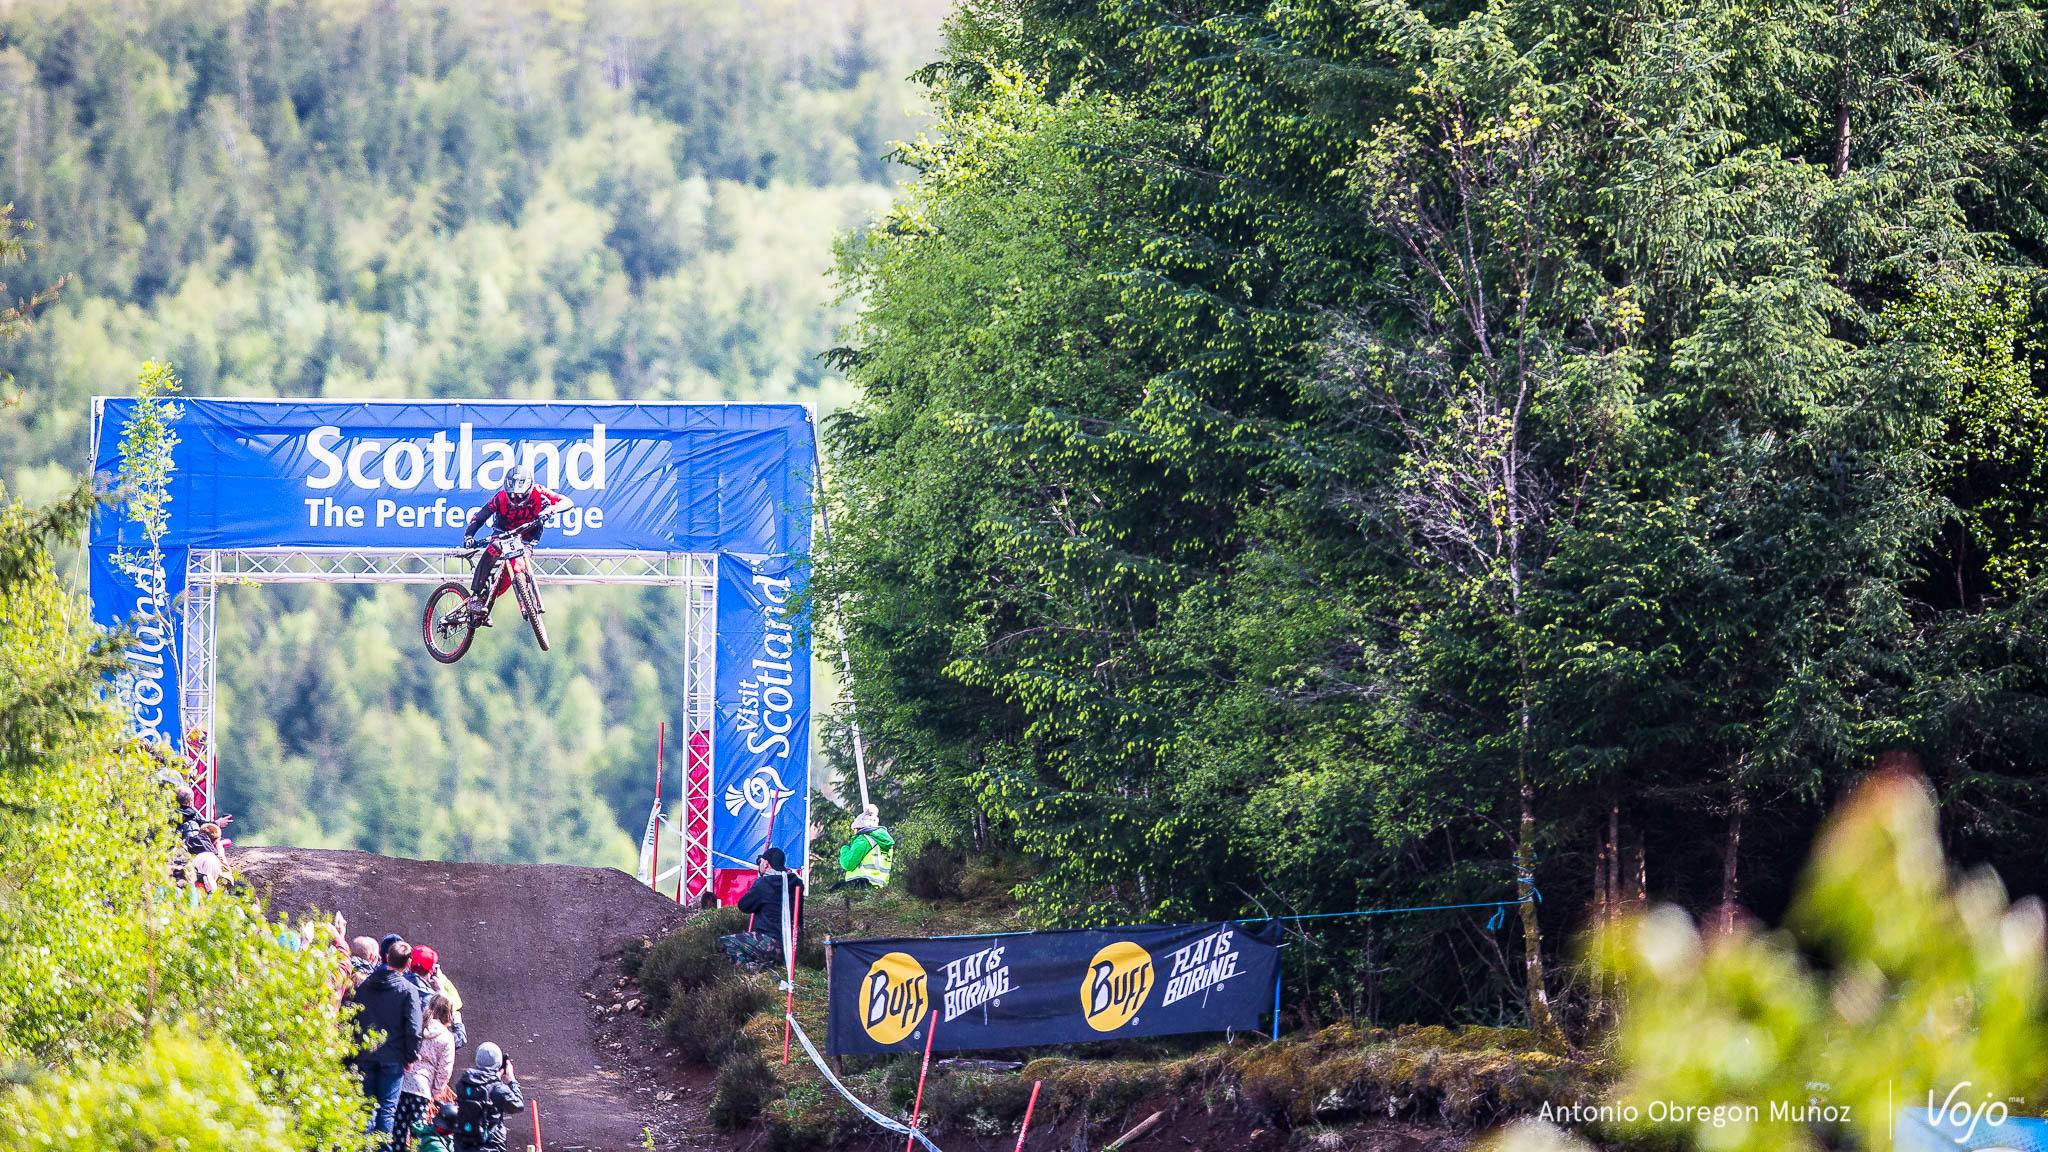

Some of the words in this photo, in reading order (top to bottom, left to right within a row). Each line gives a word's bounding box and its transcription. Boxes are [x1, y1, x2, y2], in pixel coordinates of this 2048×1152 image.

[306, 422, 606, 490] Scotland
[305, 497, 365, 527] The
[377, 498, 494, 528] Perfec
[544, 505, 604, 536] age
[509, 541, 516, 551] 5
[747, 573, 793, 759] Scotland
[736, 679, 759, 733] Visit
[937, 947, 993, 991] FLAT
[986, 946, 1006, 973] IS
[1161, 951, 1242, 1008] BORING
[1164, 932, 1220, 978] FLAT
[1212, 930, 1234, 958] IS
[943, 965, 1014, 1023] BORING
